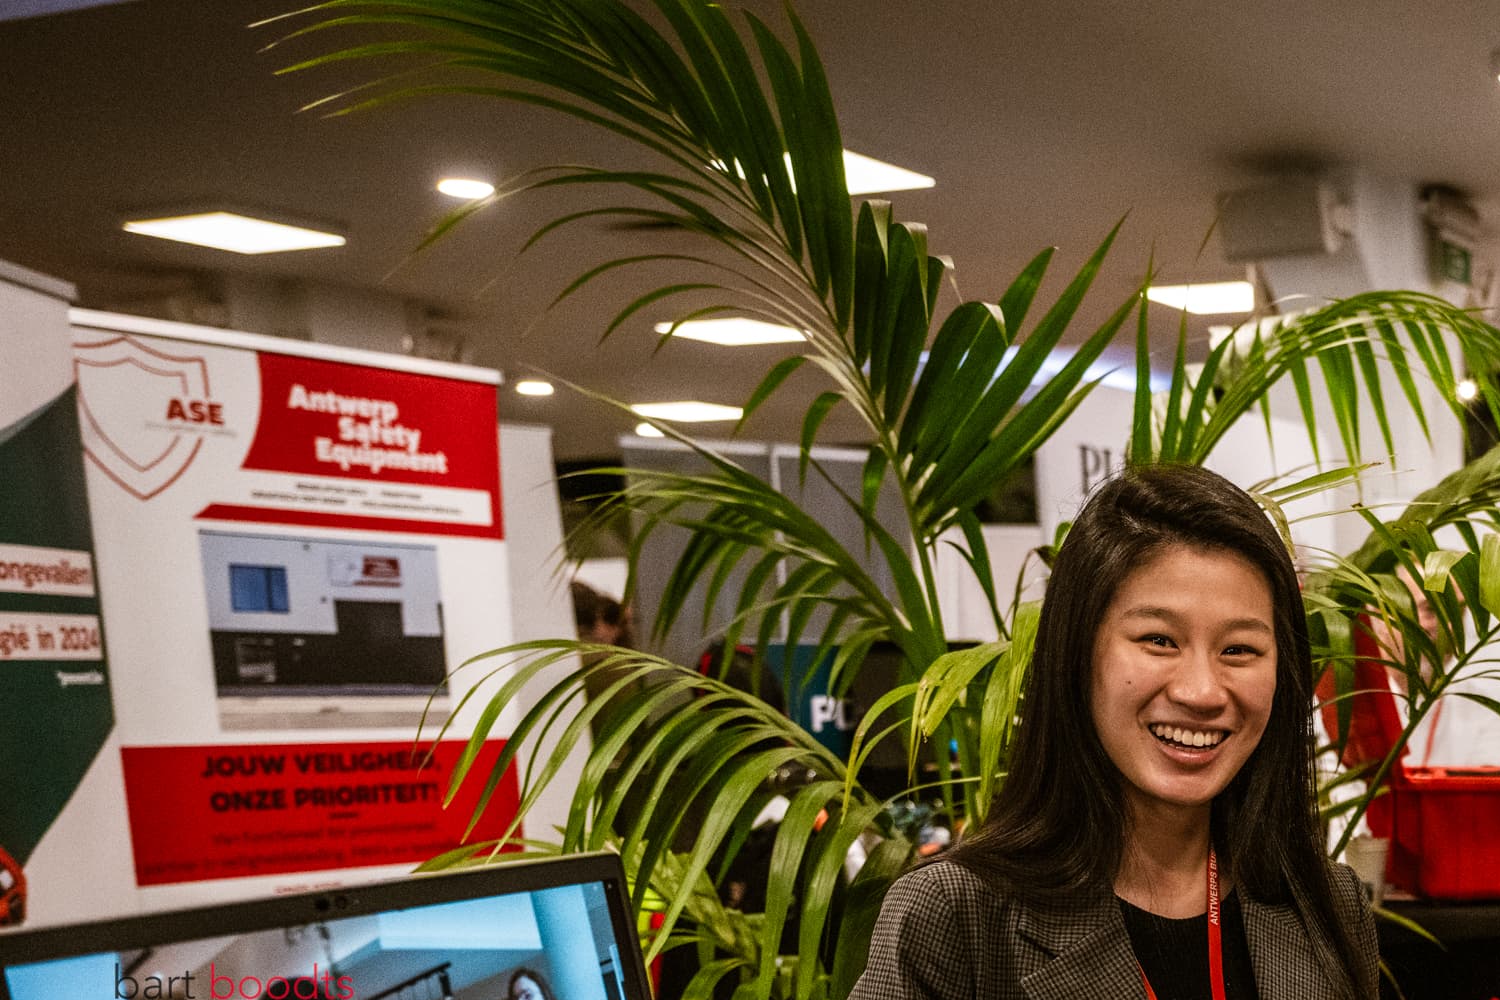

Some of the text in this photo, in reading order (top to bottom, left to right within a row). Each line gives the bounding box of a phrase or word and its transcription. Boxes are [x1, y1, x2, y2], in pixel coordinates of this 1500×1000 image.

[166, 398, 224, 426] ASE
[287, 384, 399, 421] Antwerp
[337, 416, 421, 453] Safety
[314, 437, 449, 475] Equipment
[202, 755, 286, 778] JOUW
[210, 788, 288, 812] ONZE
[1209, 871, 1219, 926] ANTWERPS
